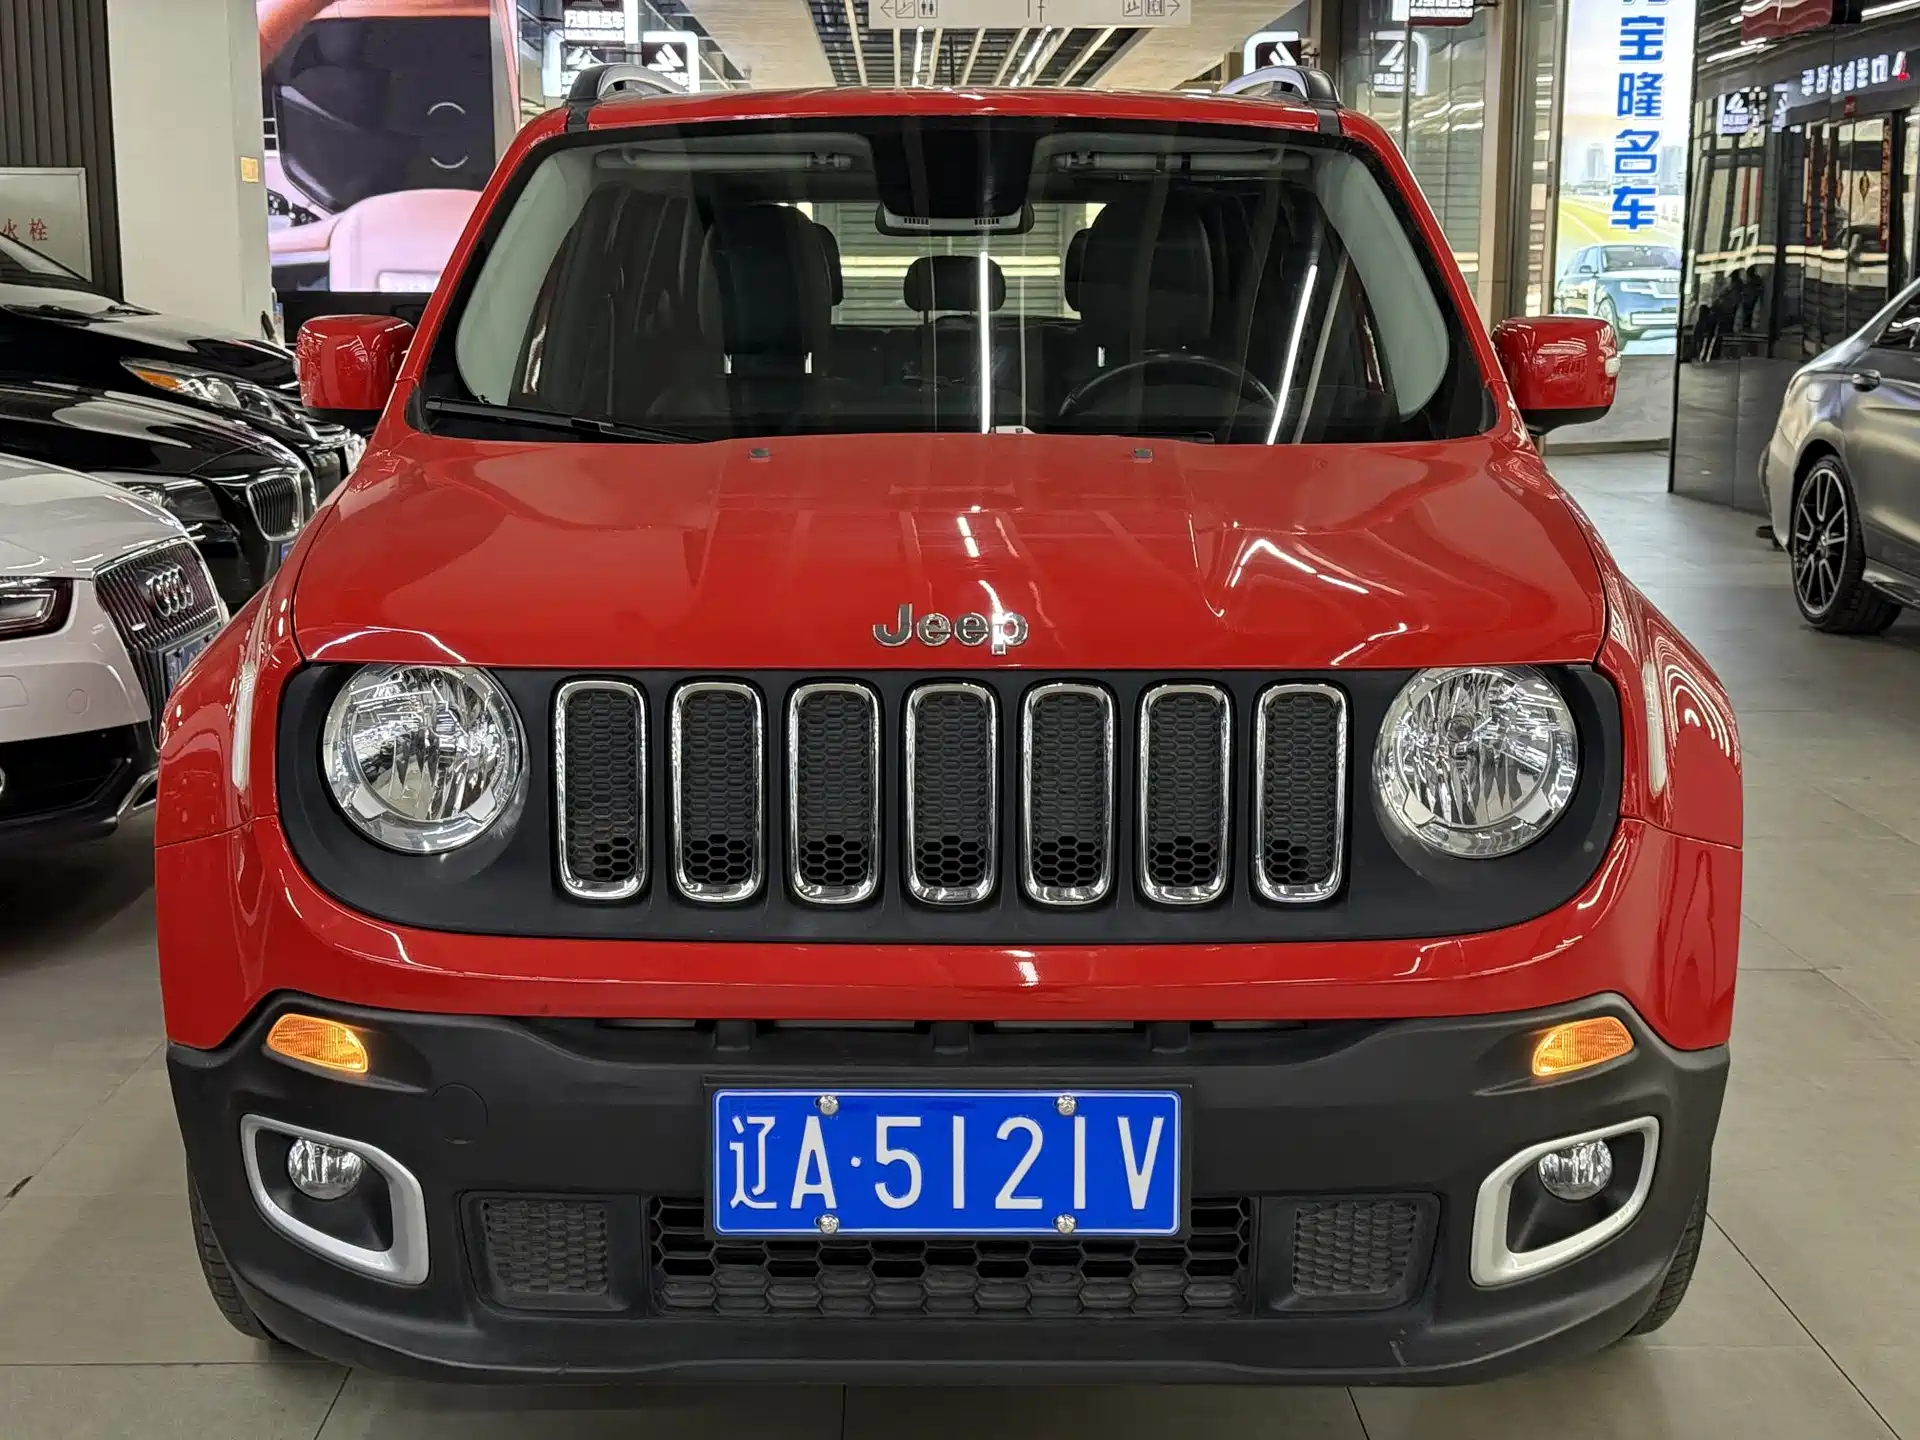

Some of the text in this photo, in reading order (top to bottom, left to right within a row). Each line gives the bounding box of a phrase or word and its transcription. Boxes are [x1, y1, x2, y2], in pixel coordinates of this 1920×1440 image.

[1612, 0, 1666, 230] 宝隆名车
[872, 603, 1029, 656] Jeep
